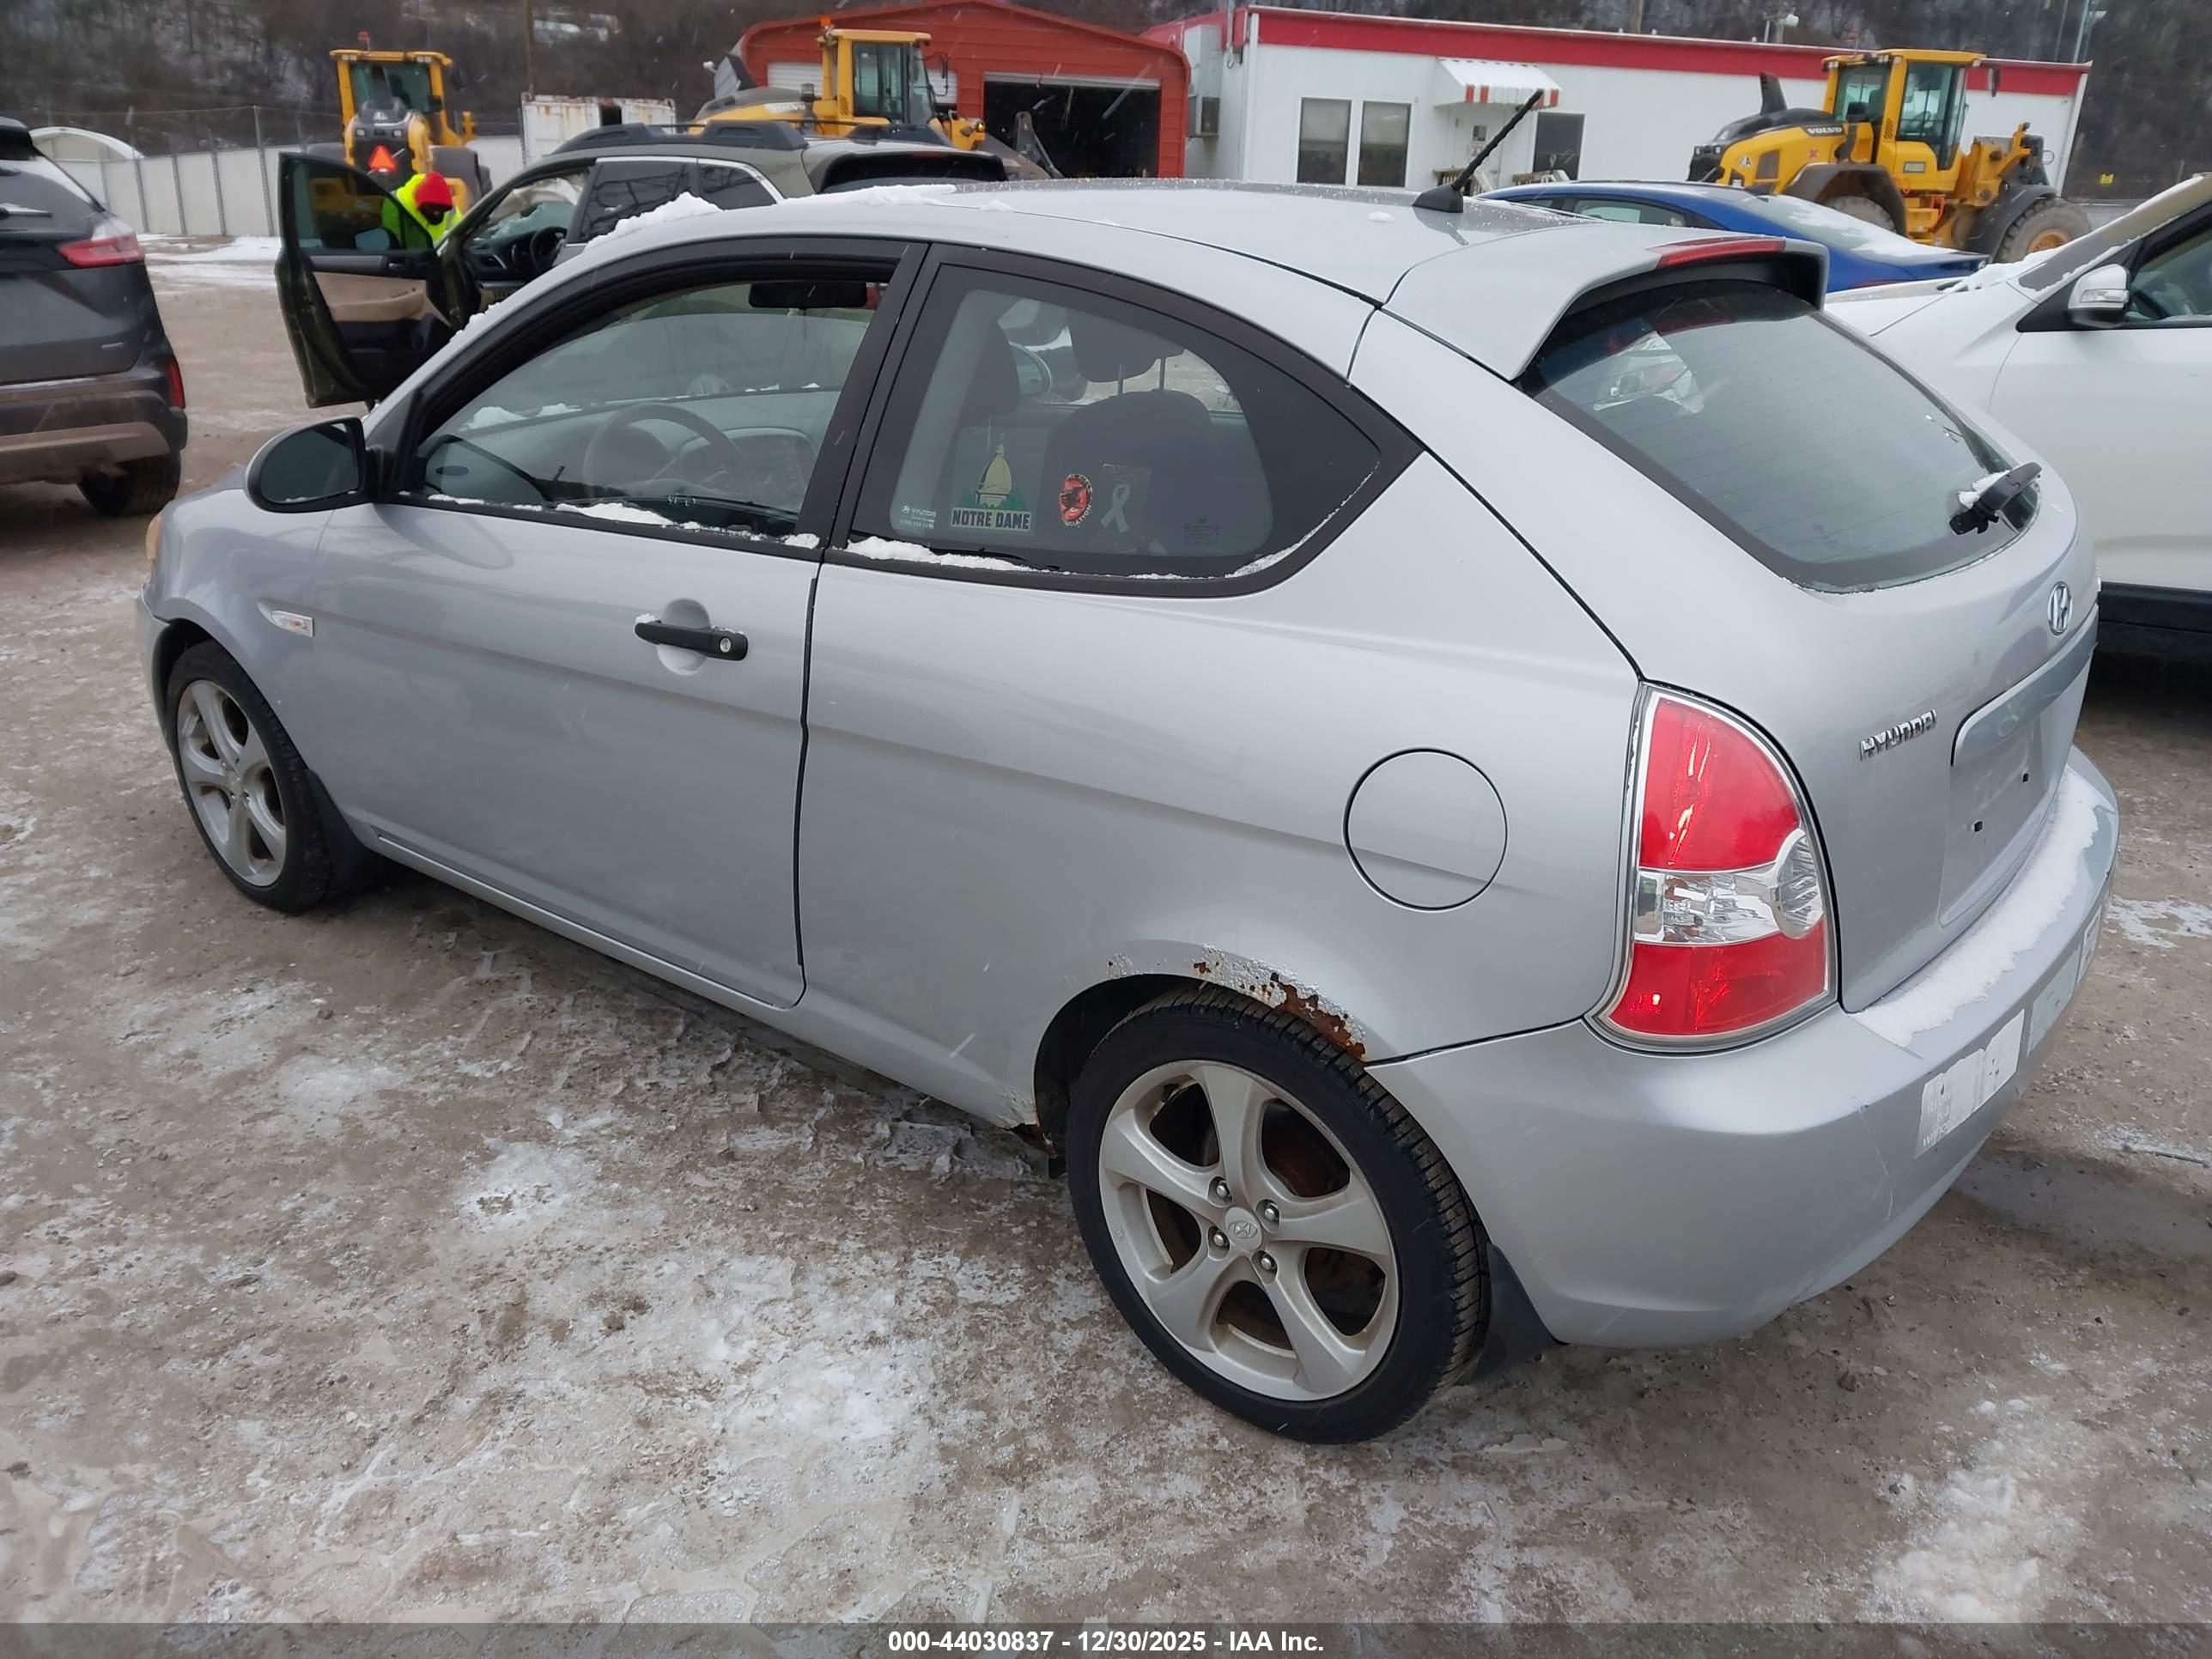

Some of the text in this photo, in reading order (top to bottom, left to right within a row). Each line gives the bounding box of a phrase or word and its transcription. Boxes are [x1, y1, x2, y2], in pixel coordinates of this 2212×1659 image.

[951, 509, 991, 526] NOTRE
[996, 512, 1030, 530] DAME
[1859, 708, 1936, 761] HYUNDAI
